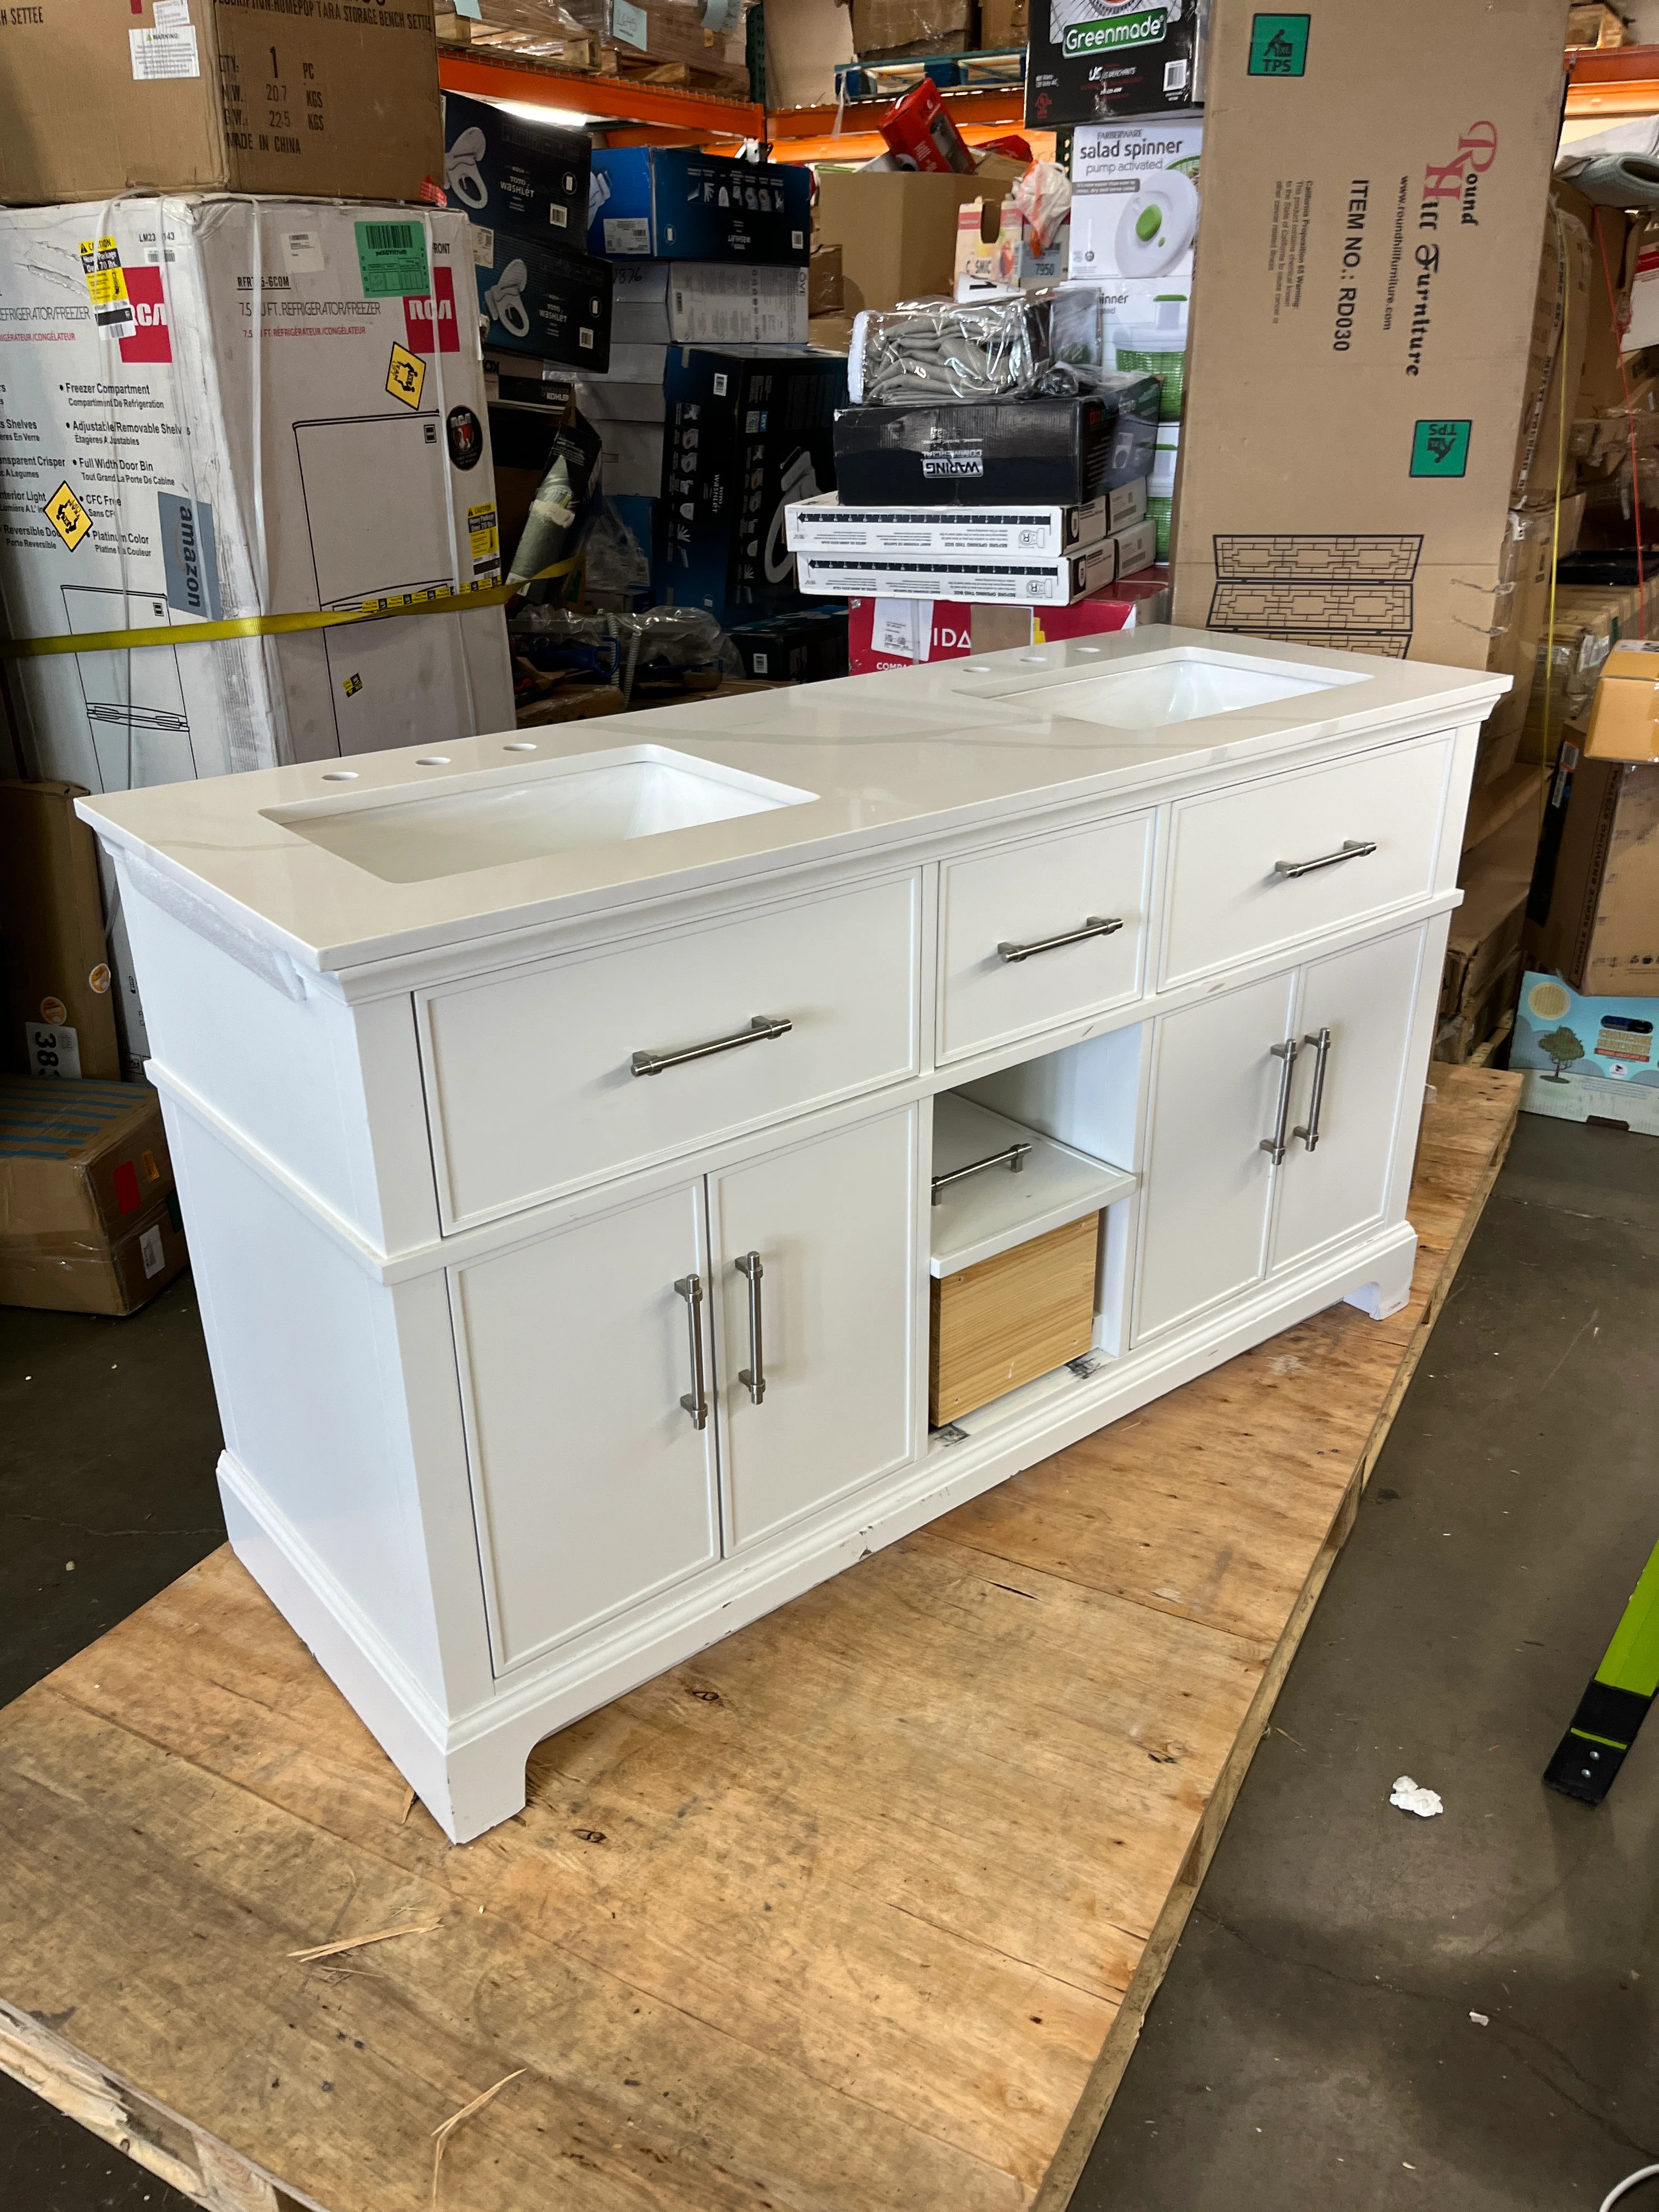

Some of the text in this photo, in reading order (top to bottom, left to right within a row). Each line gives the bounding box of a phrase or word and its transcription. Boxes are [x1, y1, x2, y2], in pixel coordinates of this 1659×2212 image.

[10, 7, 43, 25] SETTEE
[344, 5, 378, 25] STORAGE
[380, 10, 405, 28] BENCH
[1066, 15, 1161, 50] Greenmade
[270, 46, 278, 78] 1
[303, 63, 314, 80] PC
[1262, 59, 1291, 72] TPS
[266, 83, 286, 102] 20.7
[306, 90, 323, 108] KGS
[269, 110, 291, 128] 22.5
[307, 114, 325, 131] KGS
[226, 132, 301, 155] MADE IN CHINA
[1080, 138, 1183, 161] salad spinner
[1086, 159, 1164, 176] pump activated
[1347, 179, 1369, 230] ITEM
[0, 306, 91, 321] EFRIGERATOR/FREEZER
[408, 300, 453, 320] RCA
[1405, 244, 1439, 376] Furniture
[1333, 287, 1357, 352] RD030
[65, 382, 150, 396] Freezer Compartment
[114, 398, 123, 408] De
[6, 419, 37, 430] Shelves
[161, 423, 191, 436] Shelvs
[1429, 424, 1457, 436] TPS
[14, 432, 22, 441] En
[0, 456, 65, 469] ansparent Crisper
[78, 458, 154, 472] Full Width Door Bin
[926, 459, 980, 474] WARING
[97, 473, 116, 482] Grand
[117, 475, 125, 483] La
[126, 475, 143, 484] Porte
[143, 476, 153, 484] De
[153, 476, 175, 486] Cabine
[0, 492, 47, 503] nterior Light
[86, 494, 103, 505] CFC
[88, 509, 115, 518] Sans CF
[4, 524, 61, 537] Reversible Doo
[92, 531, 149, 544] Platinm Color
[127, 546, 151, 557] Couleur
[179, 506, 201, 608] amazon
